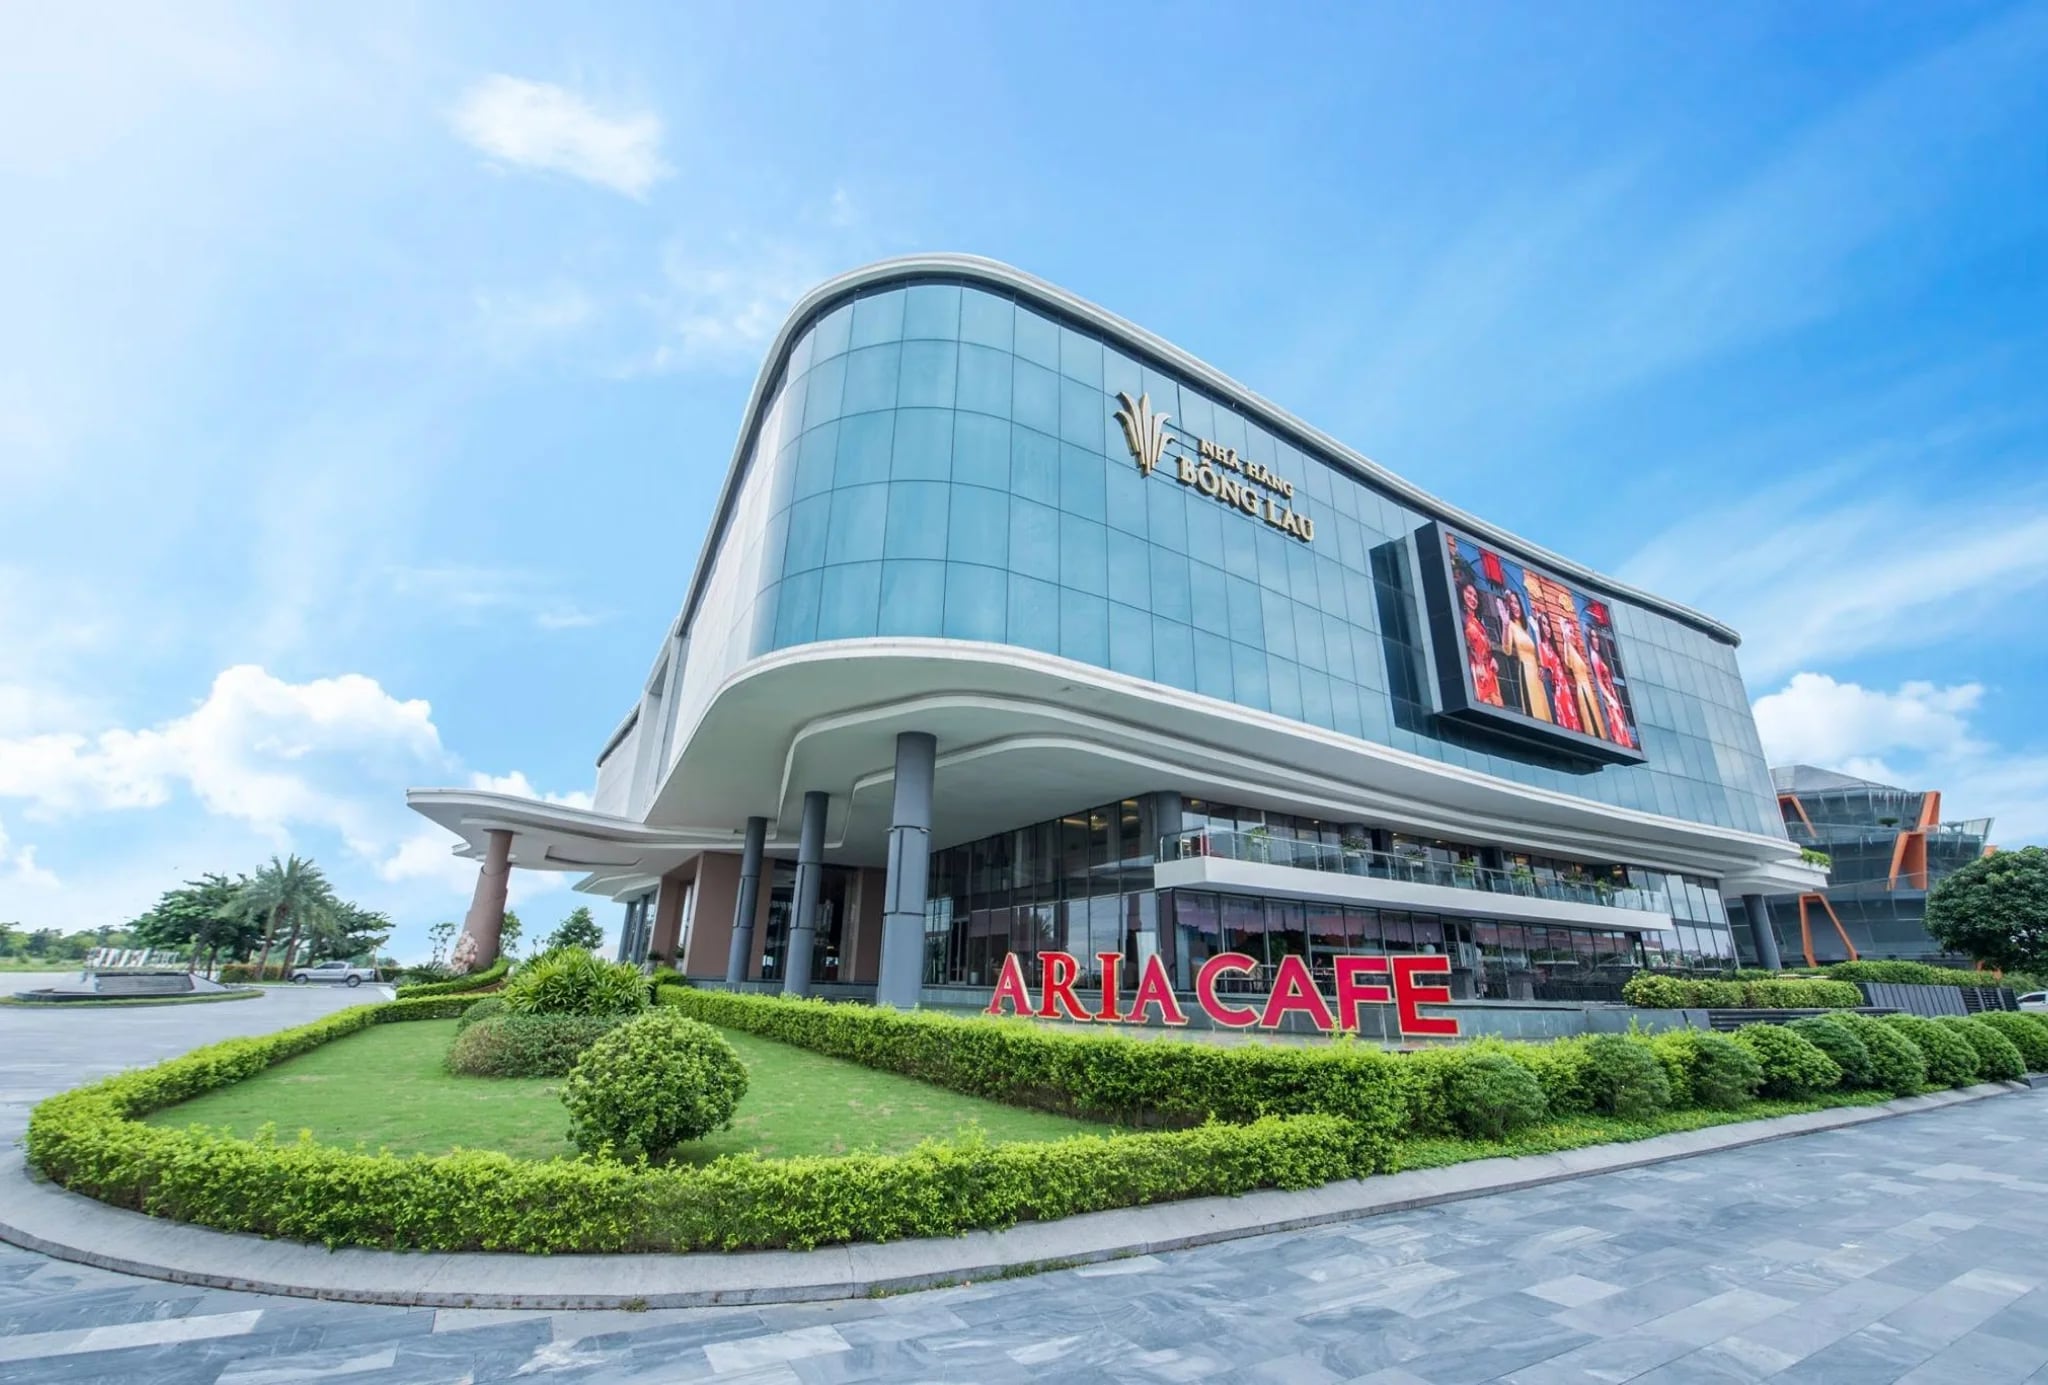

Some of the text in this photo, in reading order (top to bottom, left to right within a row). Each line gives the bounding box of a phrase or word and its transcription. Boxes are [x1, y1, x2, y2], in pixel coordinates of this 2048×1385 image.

[1178, 454, 1315, 542] BÔNG LAU
[984, 951, 1461, 1036] ARIA CAFE
